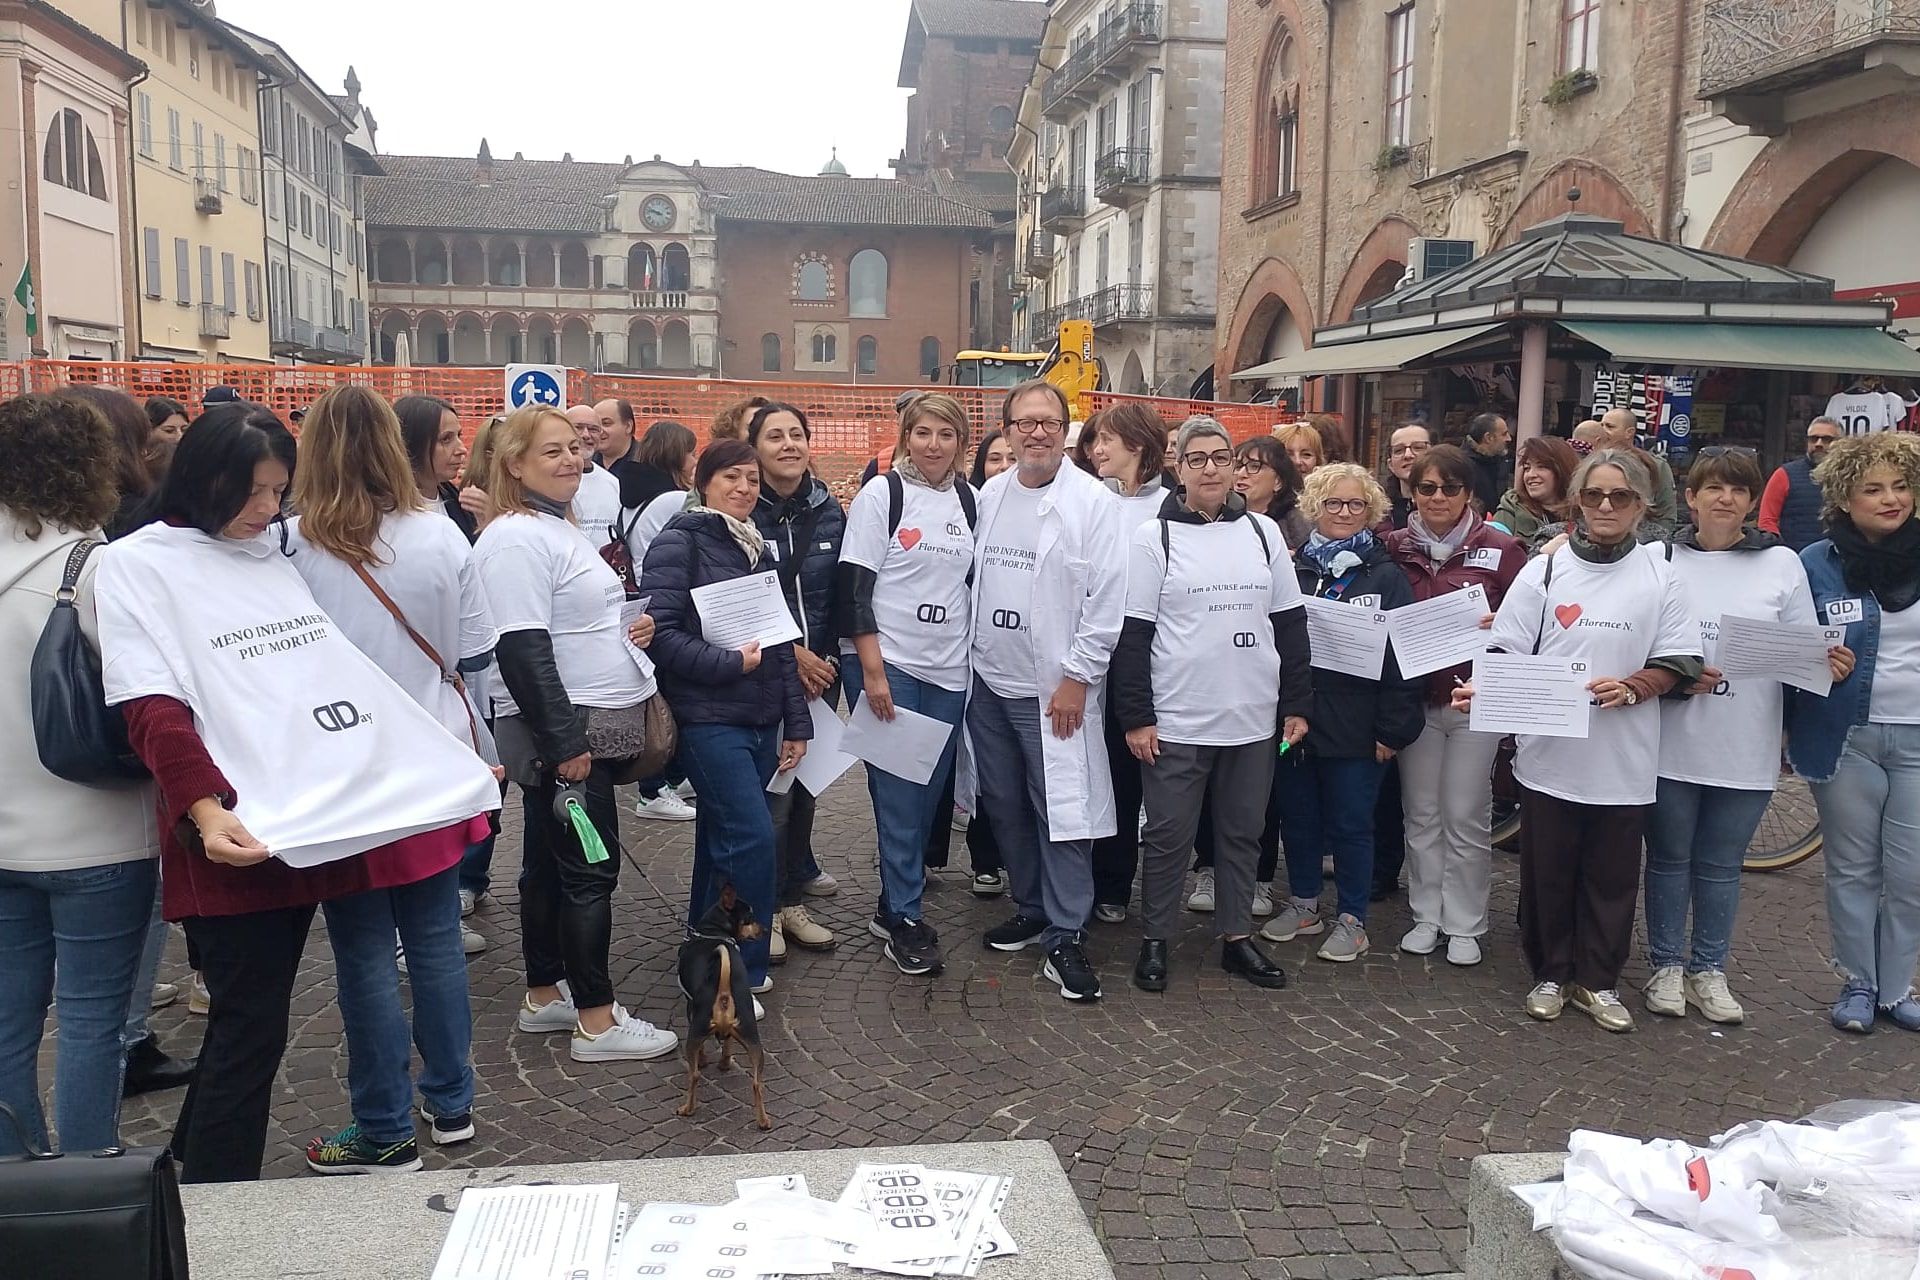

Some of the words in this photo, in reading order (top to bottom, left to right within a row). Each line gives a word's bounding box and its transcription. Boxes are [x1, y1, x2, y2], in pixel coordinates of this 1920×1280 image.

[1842, 415, 1870, 437] 10
[918, 542, 954, 555] Florence
[984, 545, 1000, 554] ENO
[1187, 587, 1191, 595] I
[1212, 583, 1239, 592] NURSE
[1551, 621, 1555, 629] I
[1578, 618, 1621, 630] Florence
[1622, 621, 1634, 632] N.
[208, 628, 254, 650] MENO
[239, 642, 266, 660] PIU'
[267, 628, 328, 654] MORTI!!!
[1709, 680, 1735, 700] Day
